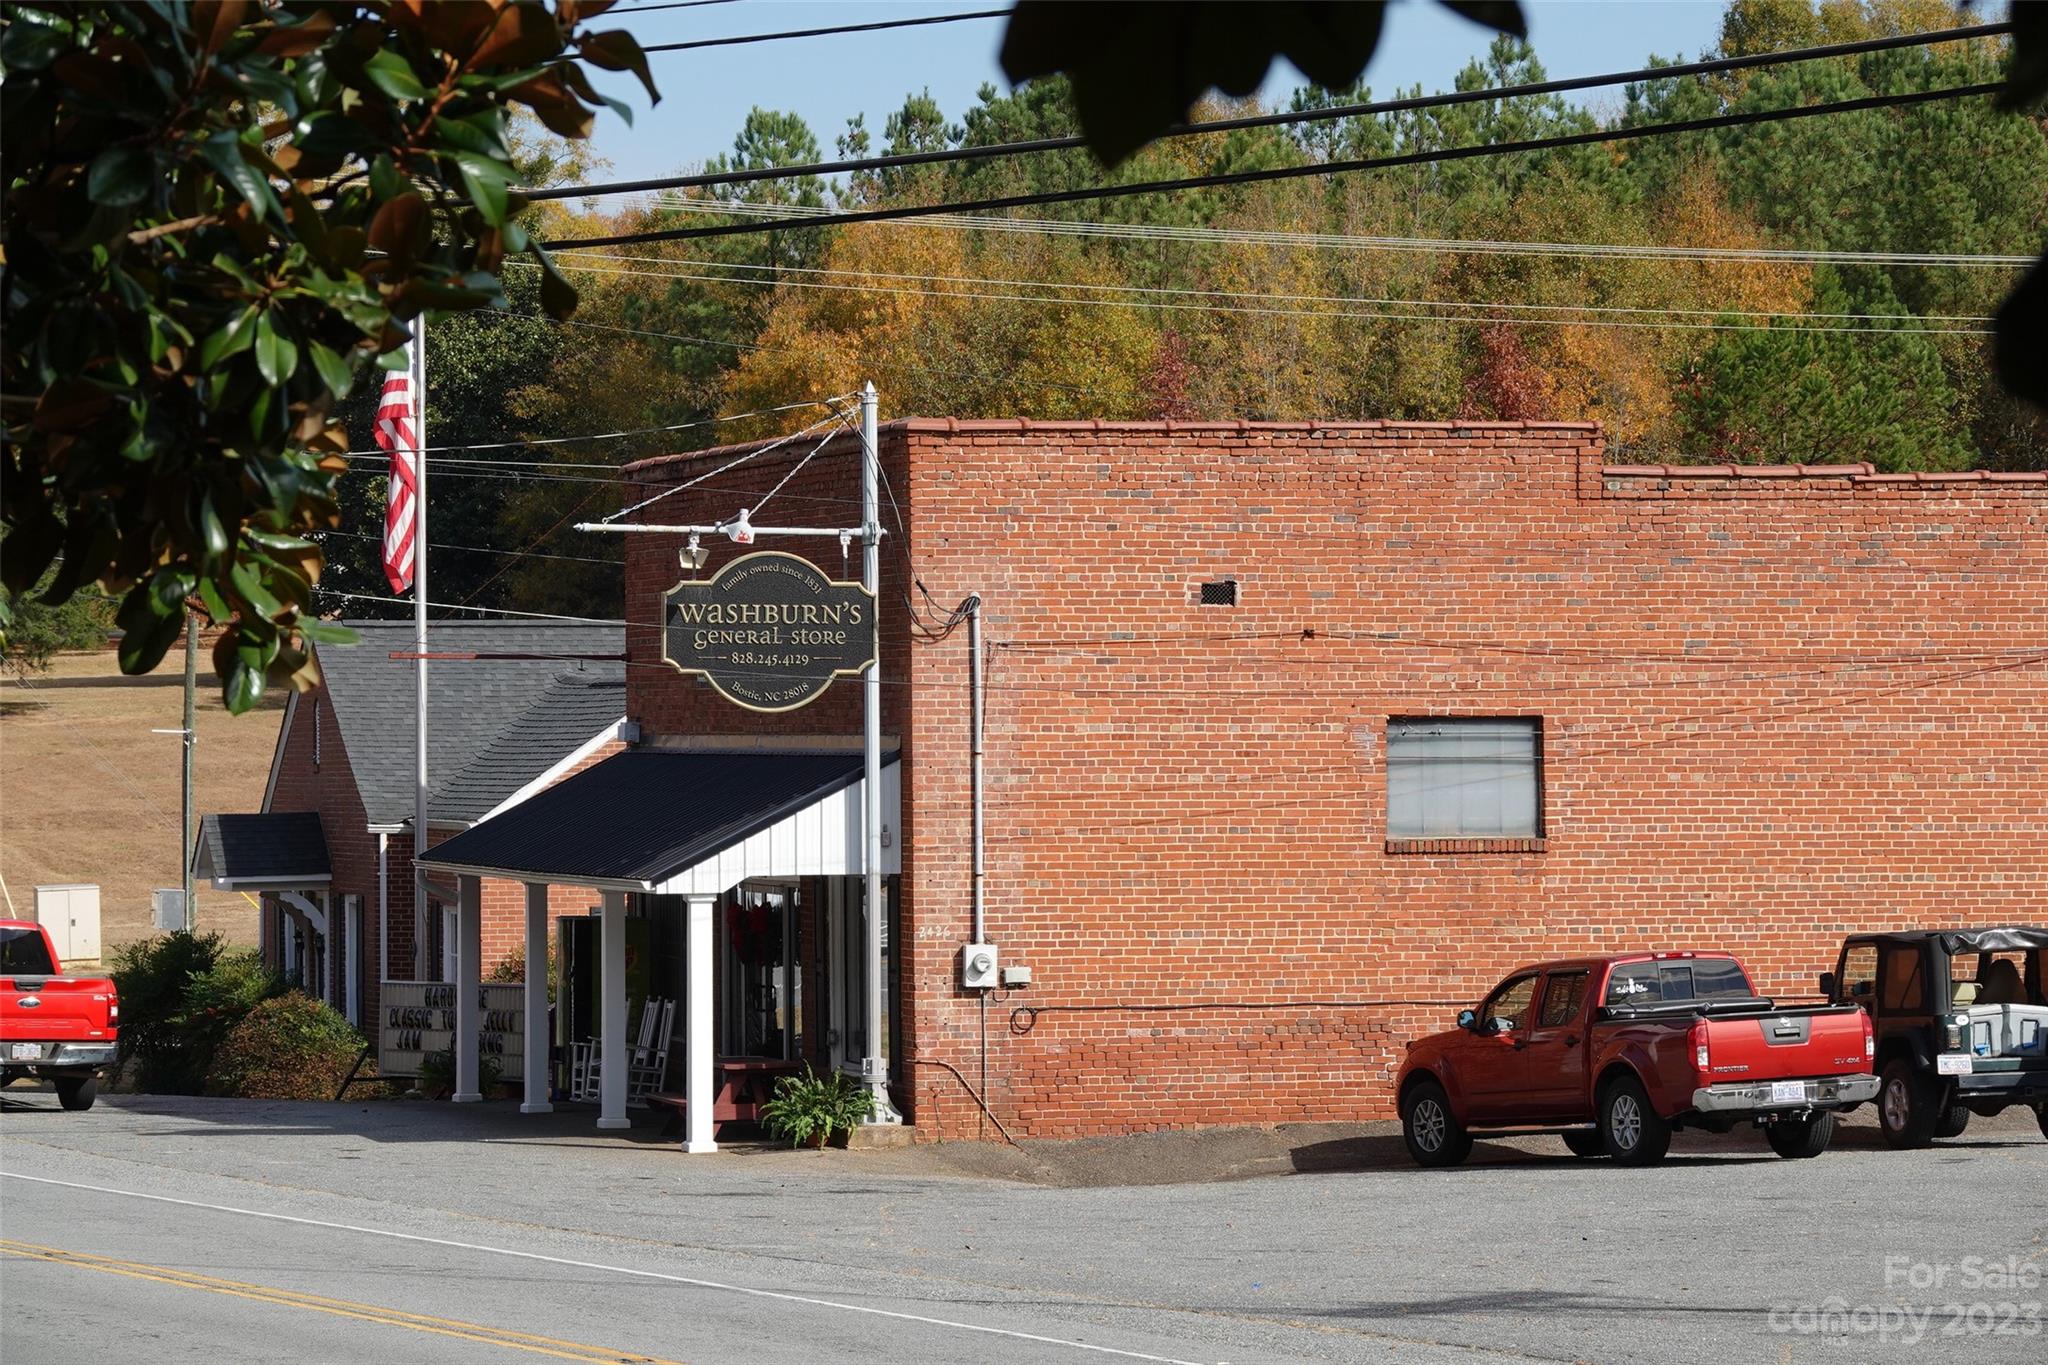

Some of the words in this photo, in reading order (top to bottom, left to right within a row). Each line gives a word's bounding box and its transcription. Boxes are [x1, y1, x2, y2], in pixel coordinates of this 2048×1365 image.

[722, 570, 748, 591] family
[749, 563, 780, 575] owned
[781, 564, 804, 580] since
[804, 575, 823, 594] 1831
[731, 652, 809, 666] 828.245.4129
[731, 681, 761, 701] Bostic,
[764, 691, 781, 701] NC
[783, 682, 810, 700] 28018
[918, 925, 951, 938] 2426
[389, 1008, 433, 1030] CLASSIC
[396, 1030, 422, 1050] JAM
[1713, 1064, 1750, 1072] FRONTIER
